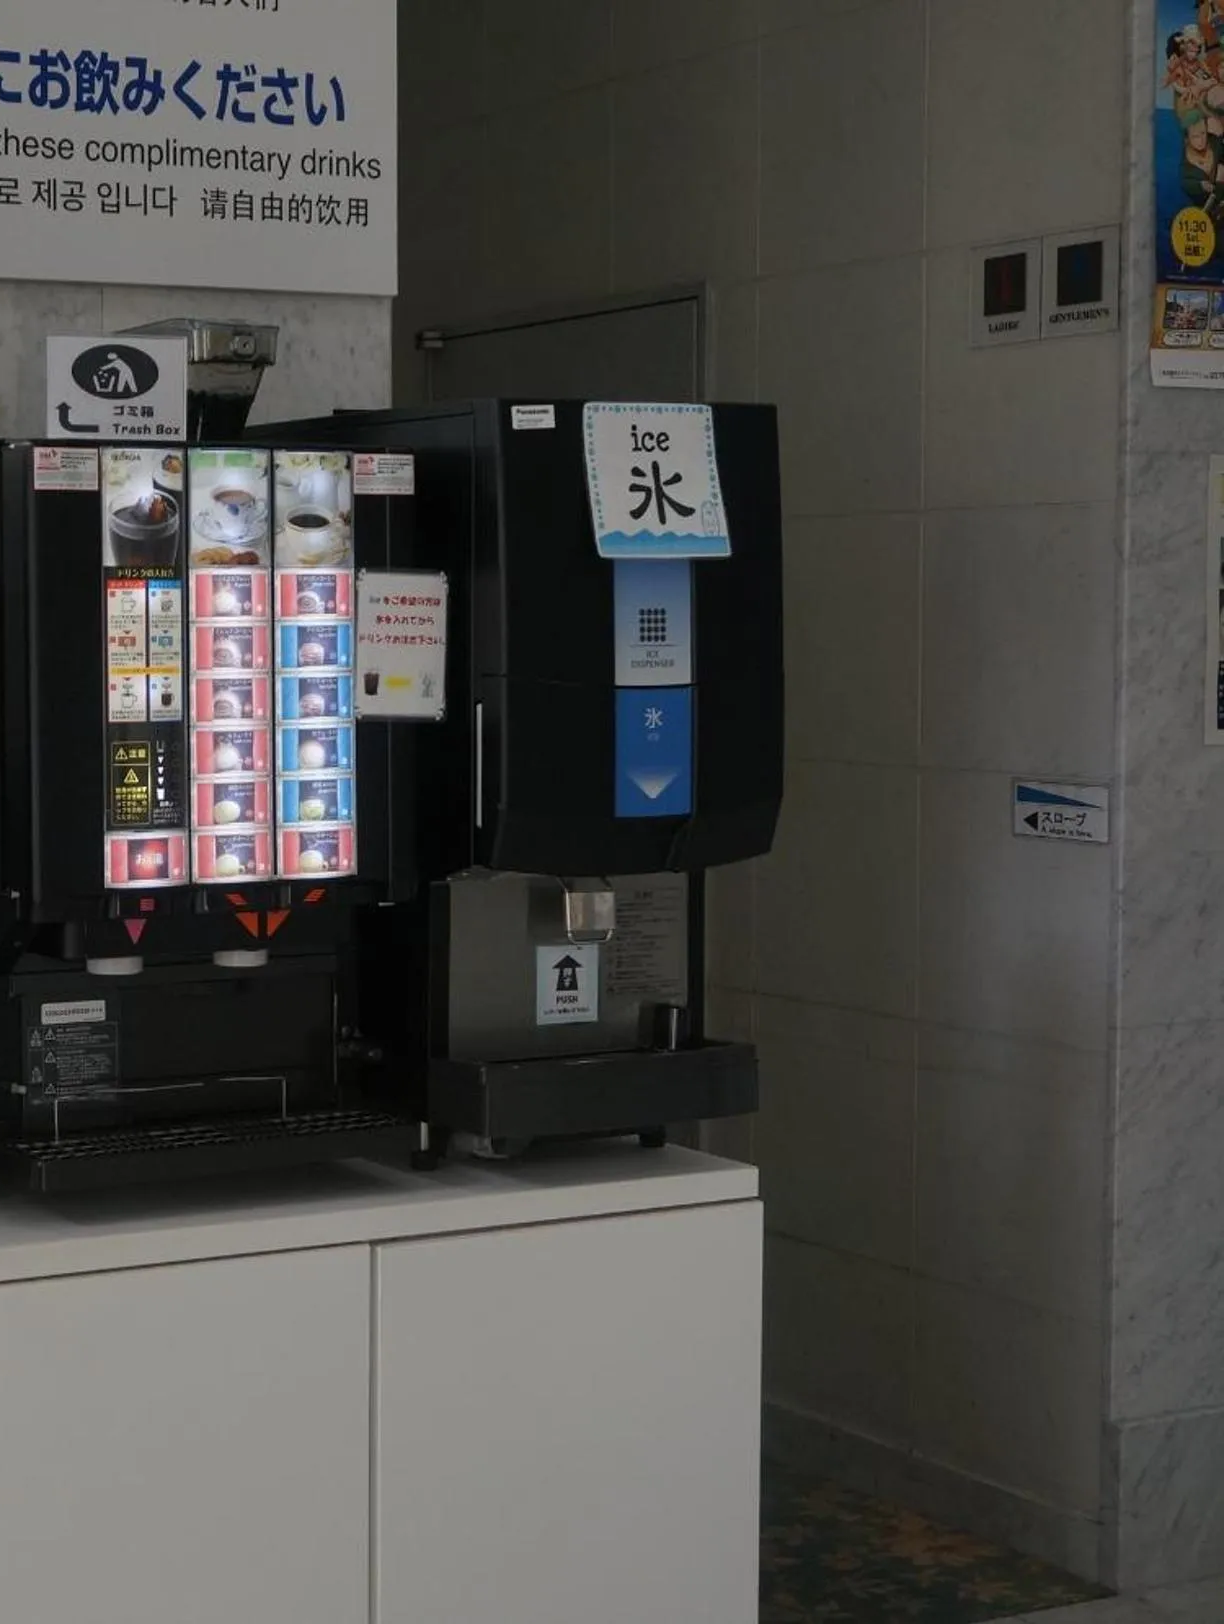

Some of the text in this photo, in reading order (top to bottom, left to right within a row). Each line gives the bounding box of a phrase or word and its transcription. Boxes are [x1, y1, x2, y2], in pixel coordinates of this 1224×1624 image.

[84, 137, 292, 180] complimentary
[300, 148, 382, 180] drinks
[31, 178, 87, 212] 제공
[97, 182, 179, 218] 입니다
[200, 188, 370, 228] 请自由的饮用
[114, 405, 154, 418] ゴミ箱
[112, 423, 181, 435] Trash Box
[631, 424, 670, 453] ice
[629, 460, 696, 525] 氷
[644, 708, 663, 729] 氷
